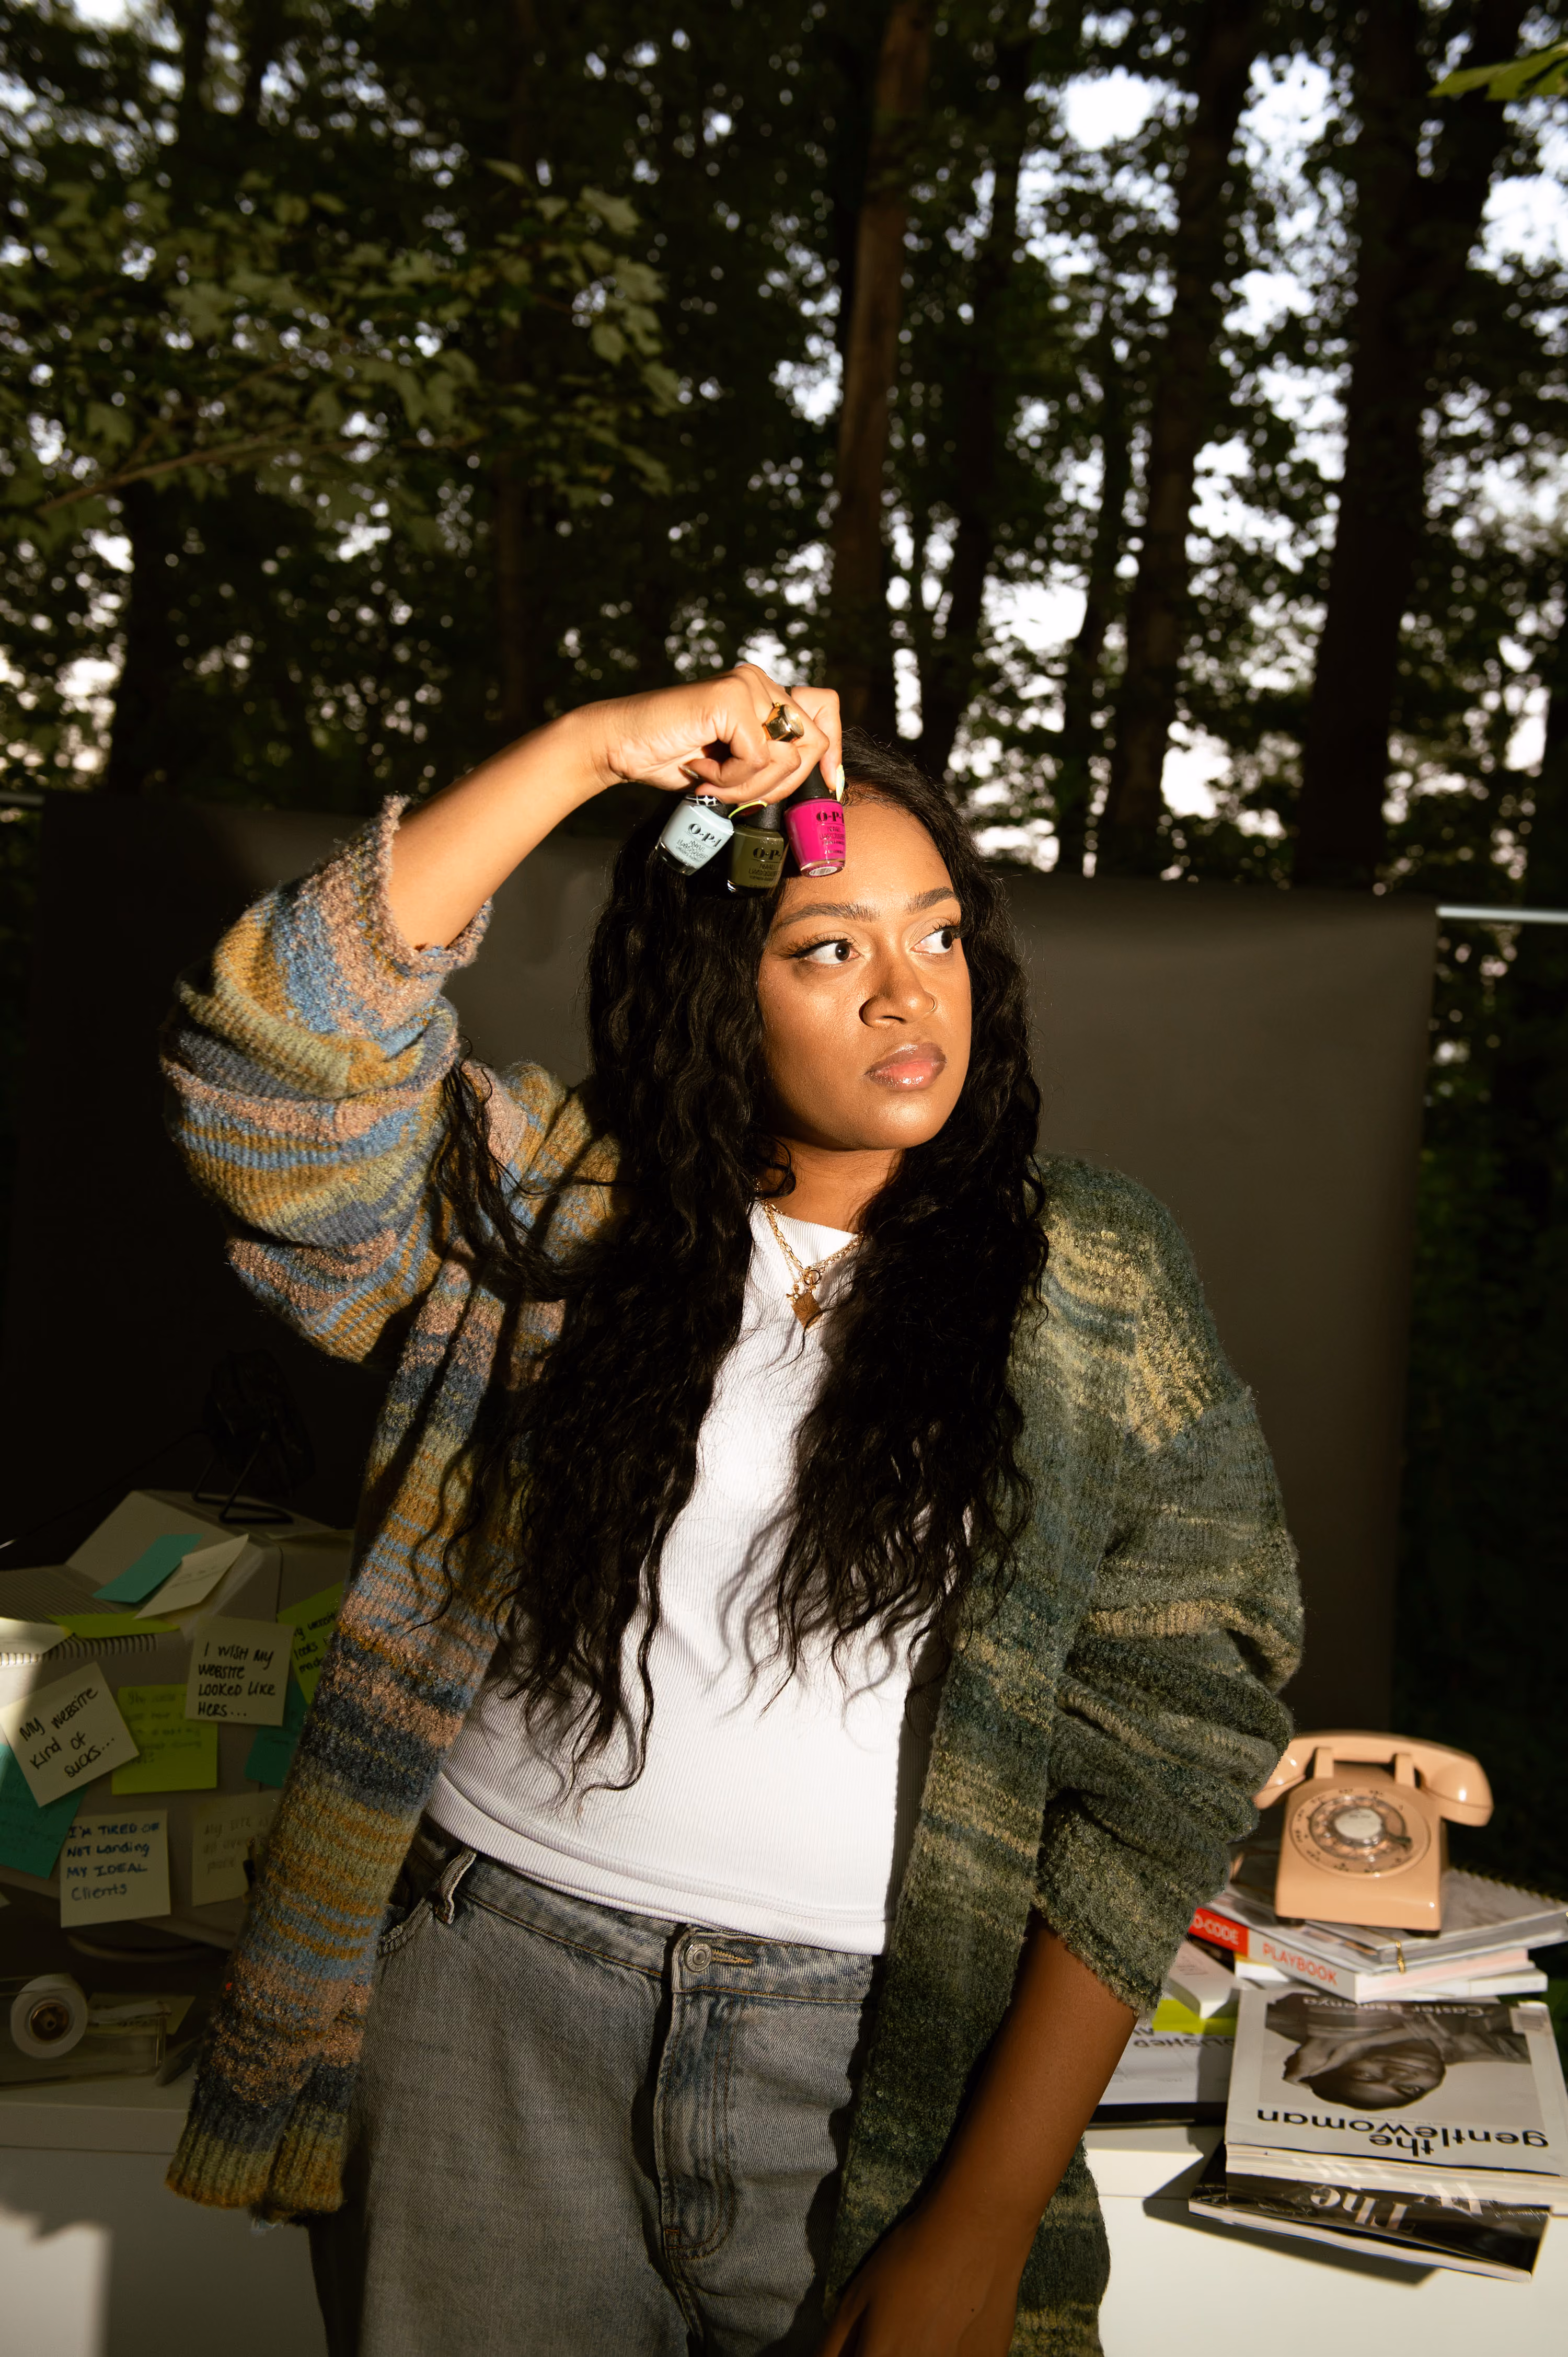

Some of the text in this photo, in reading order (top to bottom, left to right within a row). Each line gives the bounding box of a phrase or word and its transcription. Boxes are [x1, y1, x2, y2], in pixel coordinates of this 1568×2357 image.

[204, 1642, 210, 1657] I
[218, 1645, 249, 1660] WISH
[98, 1822, 137, 1835] TIRED
[67, 1845, 91, 1857] NOT
[94, 1862, 147, 1877] IDEAL
[1193, 1914, 1338, 1986] O-CODE PLAYBOOK
[1256, 2109, 1549, 2148] gentlewoman
[1369, 2133, 1434, 2157] the
[1310, 2185, 1416, 2235] The
